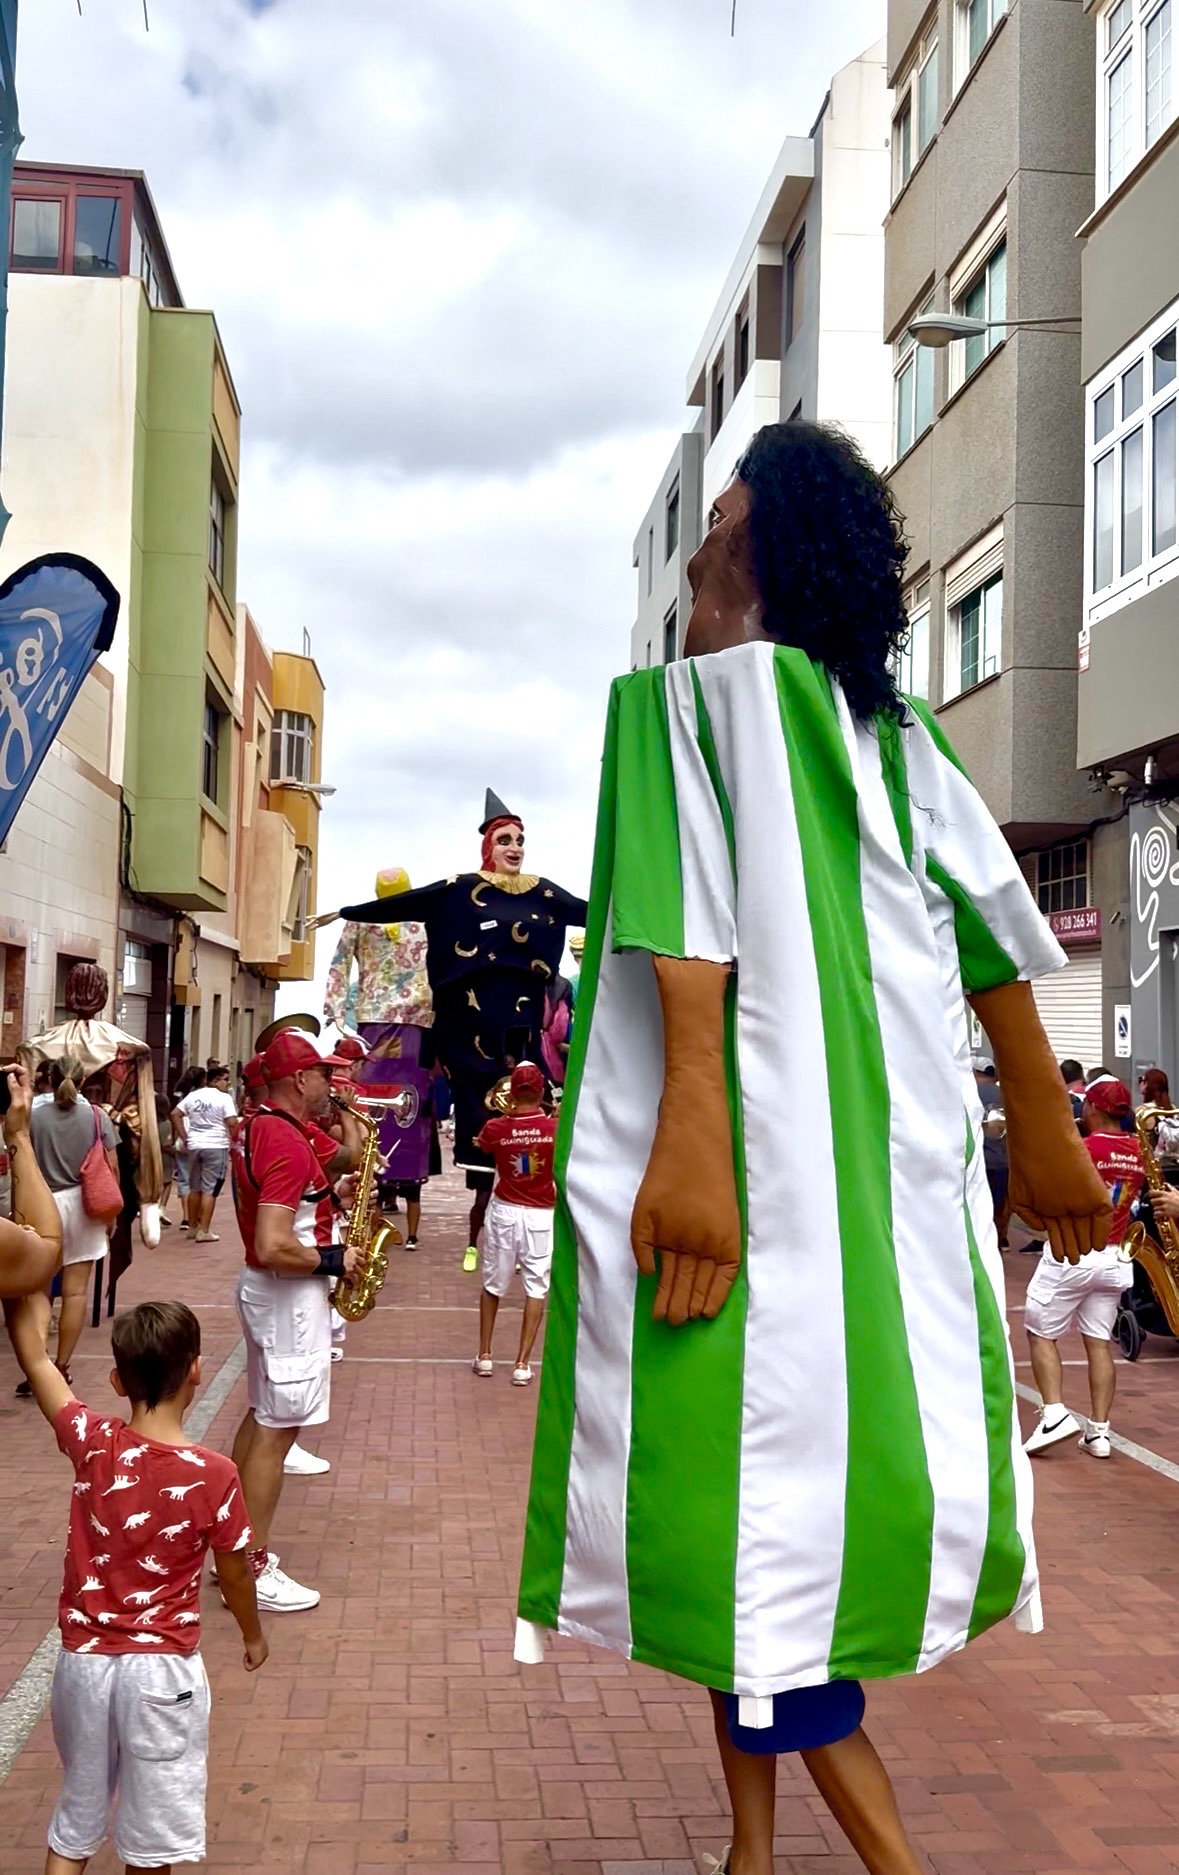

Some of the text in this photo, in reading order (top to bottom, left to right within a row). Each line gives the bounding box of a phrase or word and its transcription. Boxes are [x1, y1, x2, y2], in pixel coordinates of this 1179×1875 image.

[1060, 912, 1097, 930] 928 266 341
[511, 1128, 541, 1137] Banda
[500, 1136, 553, 1146] Guiniguada
[1110, 1151, 1138, 1163] Banda
